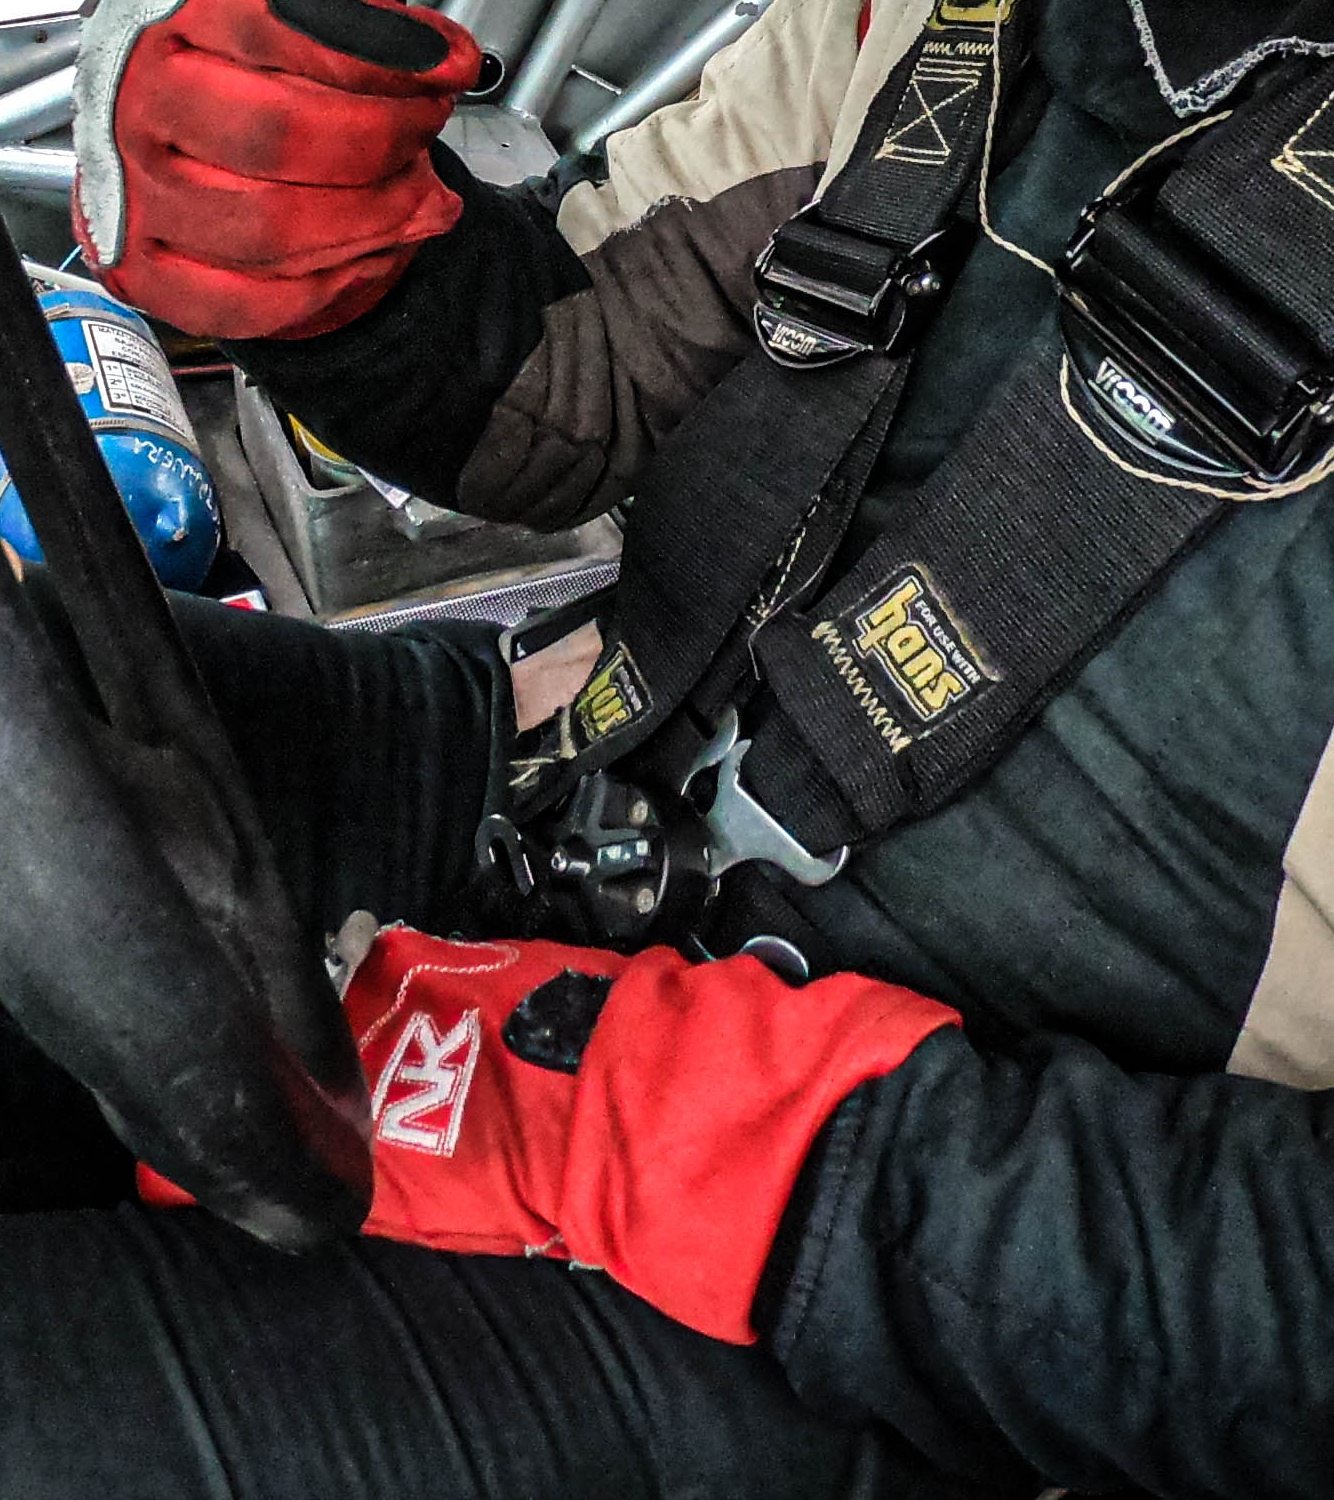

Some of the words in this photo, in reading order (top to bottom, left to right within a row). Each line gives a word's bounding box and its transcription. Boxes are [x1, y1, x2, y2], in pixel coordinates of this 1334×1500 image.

[855, 577, 967, 717] hans
[914, 600, 938, 628] FOR
[932, 626, 957, 653] USE
[950, 647, 982, 684] WITH
[376, 1010, 478, 1157] NK
